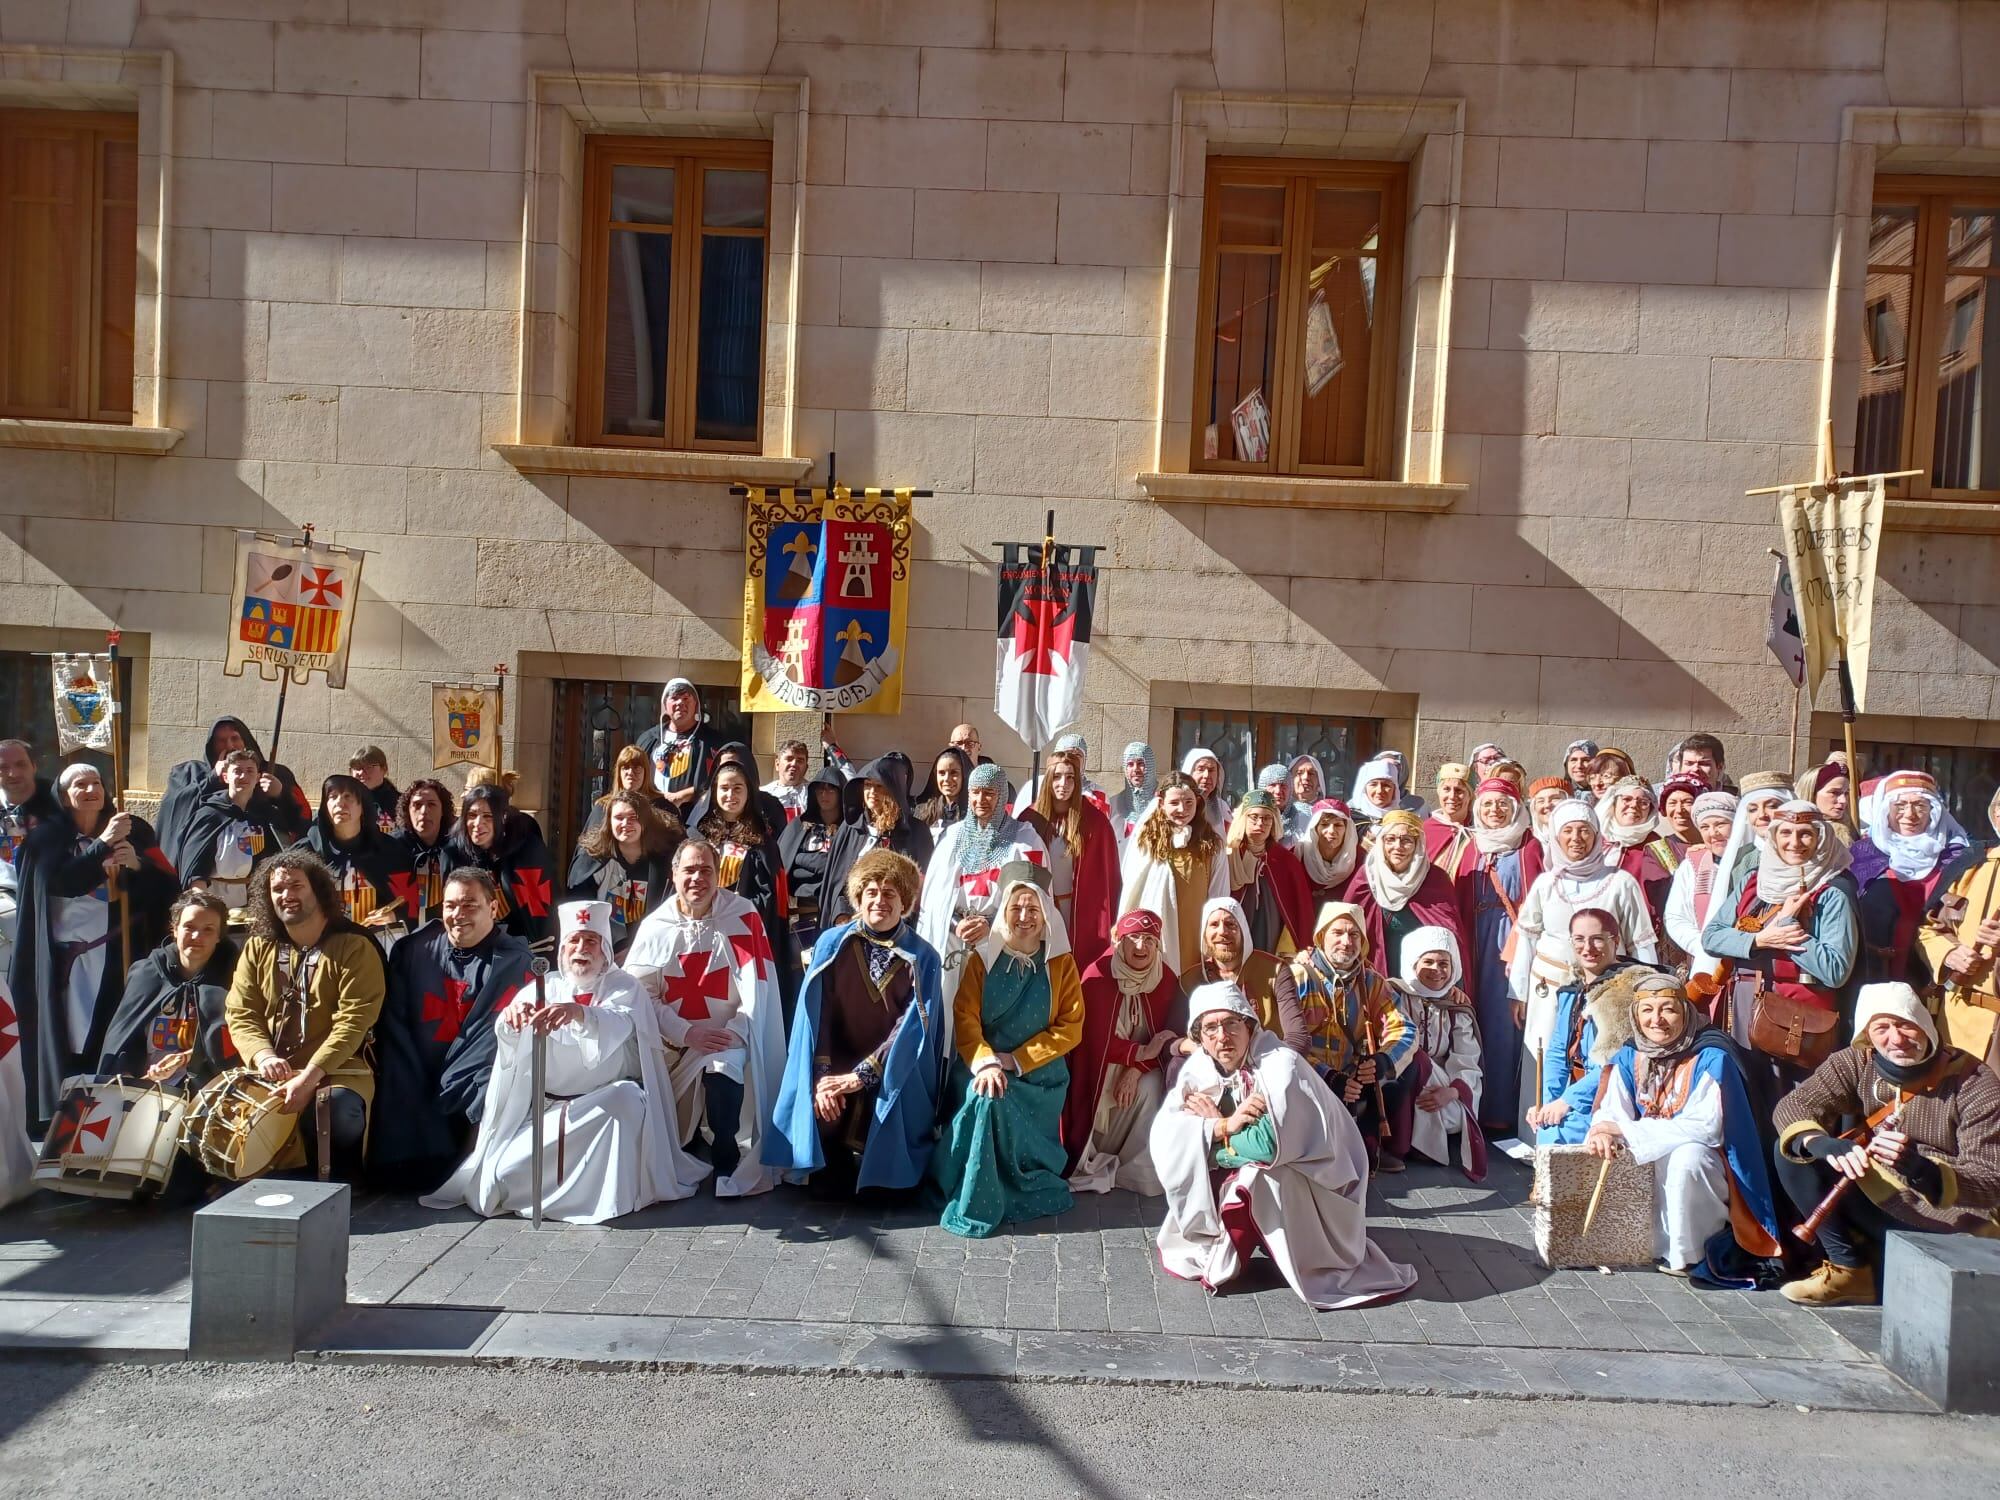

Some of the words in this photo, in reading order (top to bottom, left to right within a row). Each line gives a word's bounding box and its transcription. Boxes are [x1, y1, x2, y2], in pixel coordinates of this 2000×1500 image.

[1806, 576, 1863, 607] MOZON
[248, 645, 288, 665] SONUS
[294, 653, 328, 667] VENTI
[774, 679, 872, 710] MONZON
